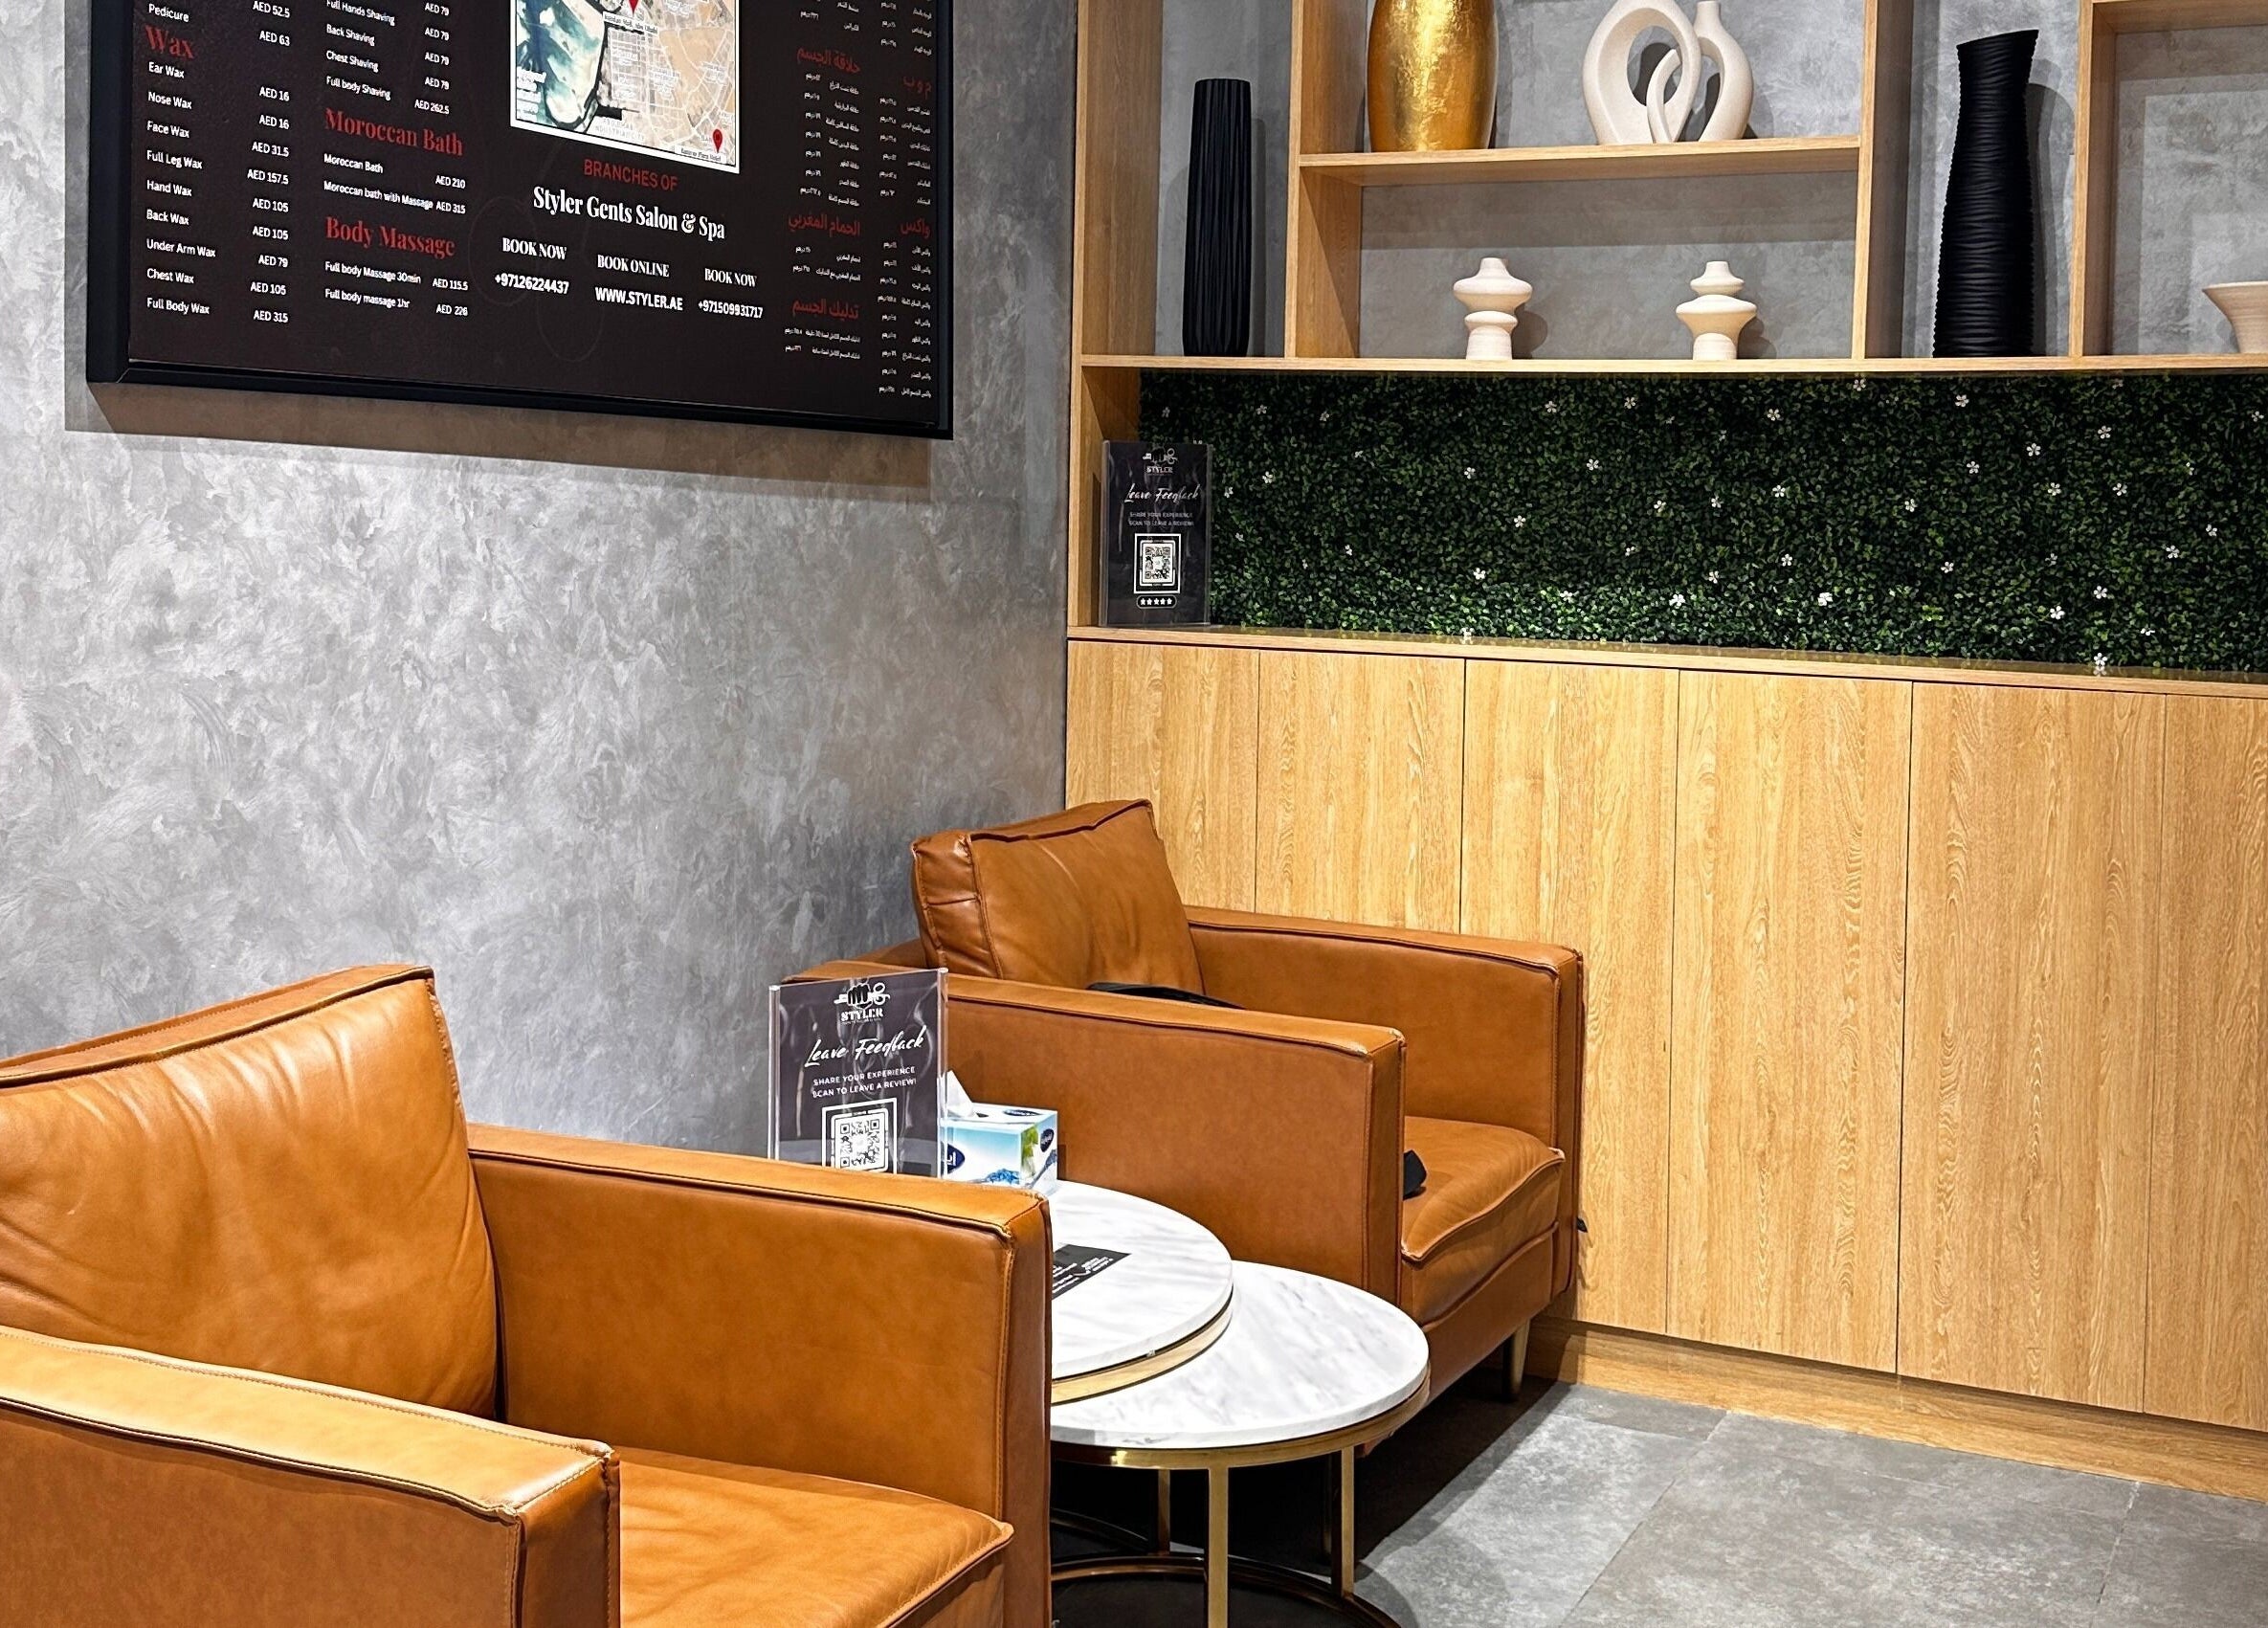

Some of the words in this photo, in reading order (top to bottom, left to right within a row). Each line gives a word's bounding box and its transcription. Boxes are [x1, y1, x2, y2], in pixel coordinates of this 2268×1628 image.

[148, 4, 189, 22] Pedicure
[253, 1, 270, 12] AED
[273, 6, 290, 18] 52.5
[342, 3, 365, 16] Hands
[367, 9, 395, 26] Shaving
[425, 3, 439, 13] AED
[259, 31, 277, 42] AED
[279, 35, 290, 46] 63
[326, 24, 345, 37] Back
[345, 29, 374, 47] Shaving
[425, 28, 439, 38] AED
[145, 25, 193, 59] Wax
[326, 51, 348, 63] Chest
[349, 56, 378, 73] Shaving
[425, 52, 439, 63] AED
[148, 62, 163, 73] Ear
[166, 65, 184, 78] Wax
[326, 76, 341, 87] Full
[342, 79, 360, 94] body
[362, 84, 390, 100] Shaving
[425, 77, 439, 87] AED
[148, 92, 171, 104] Nose
[173, 96, 191, 109] Wax
[259, 86, 277, 99] AED
[414, 100, 429, 110] AED
[147, 121, 168, 134] Face
[170, 125, 189, 138] Wax
[259, 115, 277, 126] AED
[279, 119, 289, 129] 16
[324, 108, 417, 146] Moroccan
[423, 129, 464, 156] Bath
[252, 142, 270, 153] AED
[271, 145, 289, 157] 31.5
[147, 150, 164, 163] Full
[166, 154, 182, 167] Leg
[184, 157, 202, 168] Wax
[323, 153, 363, 169] Moroccan
[366, 162, 383, 173] Bath
[247, 169, 265, 181] AED
[267, 172, 288, 185] 157.5
[435, 175, 451, 186] AED
[453, 178, 465, 189] 210
[584, 160, 657, 188] BRANCHES
[661, 174, 678, 190] OF
[147, 180, 170, 193] Hand
[173, 184, 191, 196] Wax
[323, 180, 363, 196] Moroccan
[365, 188, 382, 199] bath
[384, 192, 400, 203] with
[402, 194, 434, 210] Massage
[253, 198, 270, 209] AED
[272, 201, 288, 212] 105
[435, 201, 451, 212] AED
[453, 204, 465, 213] 315
[146, 209, 167, 221] Back
[170, 212, 189, 225] Wax
[533, 187, 583, 215] Styler
[587, 197, 633, 224] Gents
[636, 205, 678, 232] Salon
[680, 213, 697, 234] &
[699, 216, 724, 242] Spa
[253, 226, 270, 237] AED
[272, 229, 288, 240] 105
[326, 216, 374, 248] Body
[380, 226, 456, 259] Massage
[146, 238, 174, 252] Under
[176, 243, 195, 255] Arm
[197, 246, 215, 256] Wax
[502, 237, 537, 256] BOOK
[539, 242, 567, 260] NOW
[258, 255, 276, 265] AED
[278, 257, 288, 267] 79
[597, 255, 629, 272] BOOK
[631, 259, 670, 278] ONLINE
[147, 268, 173, 281] Chest
[175, 272, 194, 283] Wax
[325, 261, 340, 272] Full
[342, 263, 362, 278] body
[364, 267, 395, 281] Massage
[704, 268, 732, 284] BOOK
[734, 273, 757, 287] NOW
[251, 281, 268, 293] AED
[270, 284, 286, 295] 105
[433, 279, 448, 288] AED
[450, 280, 468, 290] 115.5
[494, 273, 568, 295] +97126224437
[147, 298, 164, 309] Full
[167, 300, 189, 315] Body
[191, 302, 210, 314] Wax
[325, 289, 340, 300] Full
[342, 291, 362, 304] body
[364, 295, 395, 308] massage
[595, 287, 683, 311] WWW.STYLER.AE
[254, 310, 271, 321] AED
[274, 312, 288, 323] 315
[436, 304, 452, 314] AED
[841, 1009, 883, 1021] STYLER
[805, 1039, 849, 1067] Leave
[856, 1025, 926, 1060] Feedback
[813, 1077, 840, 1086] SHARE
[867, 1066, 915, 1079] EXPERIENCE
[812, 1089, 834, 1098] SCAN
[850, 1083, 874, 1093] LEAVE
